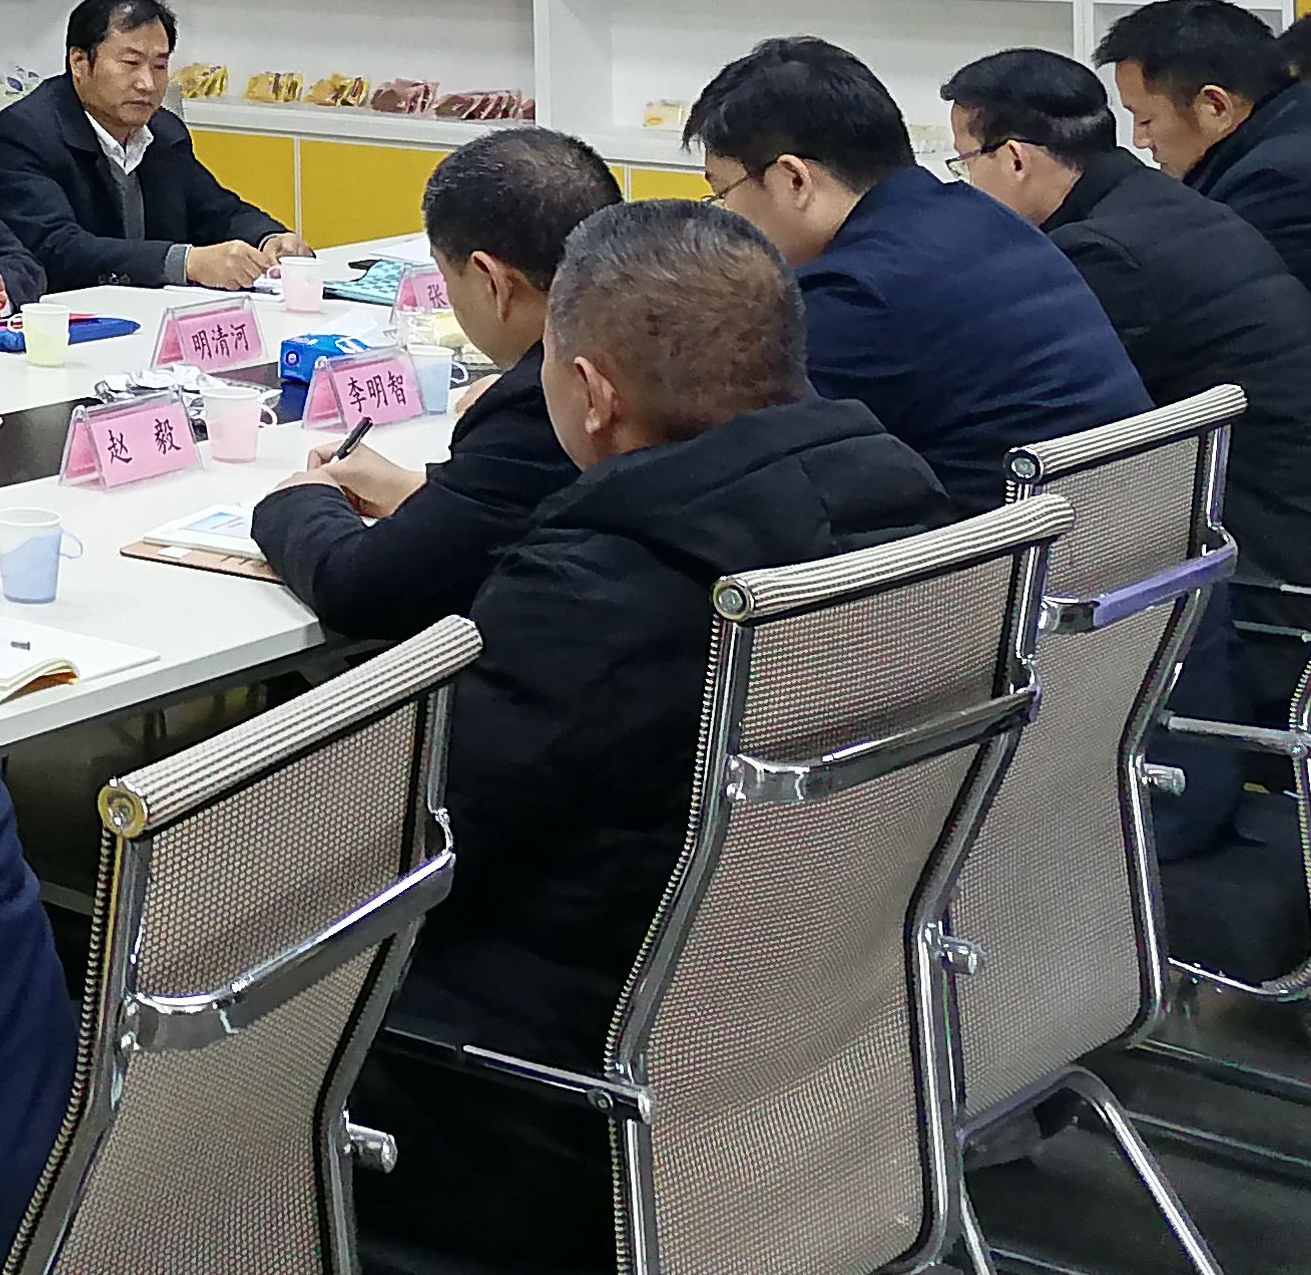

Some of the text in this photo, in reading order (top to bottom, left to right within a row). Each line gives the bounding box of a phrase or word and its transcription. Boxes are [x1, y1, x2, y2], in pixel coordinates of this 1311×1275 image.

[191, 323, 250, 361] 明清河
[347, 369, 407, 413] 李明智
[106, 418, 182, 465] 赵毅
